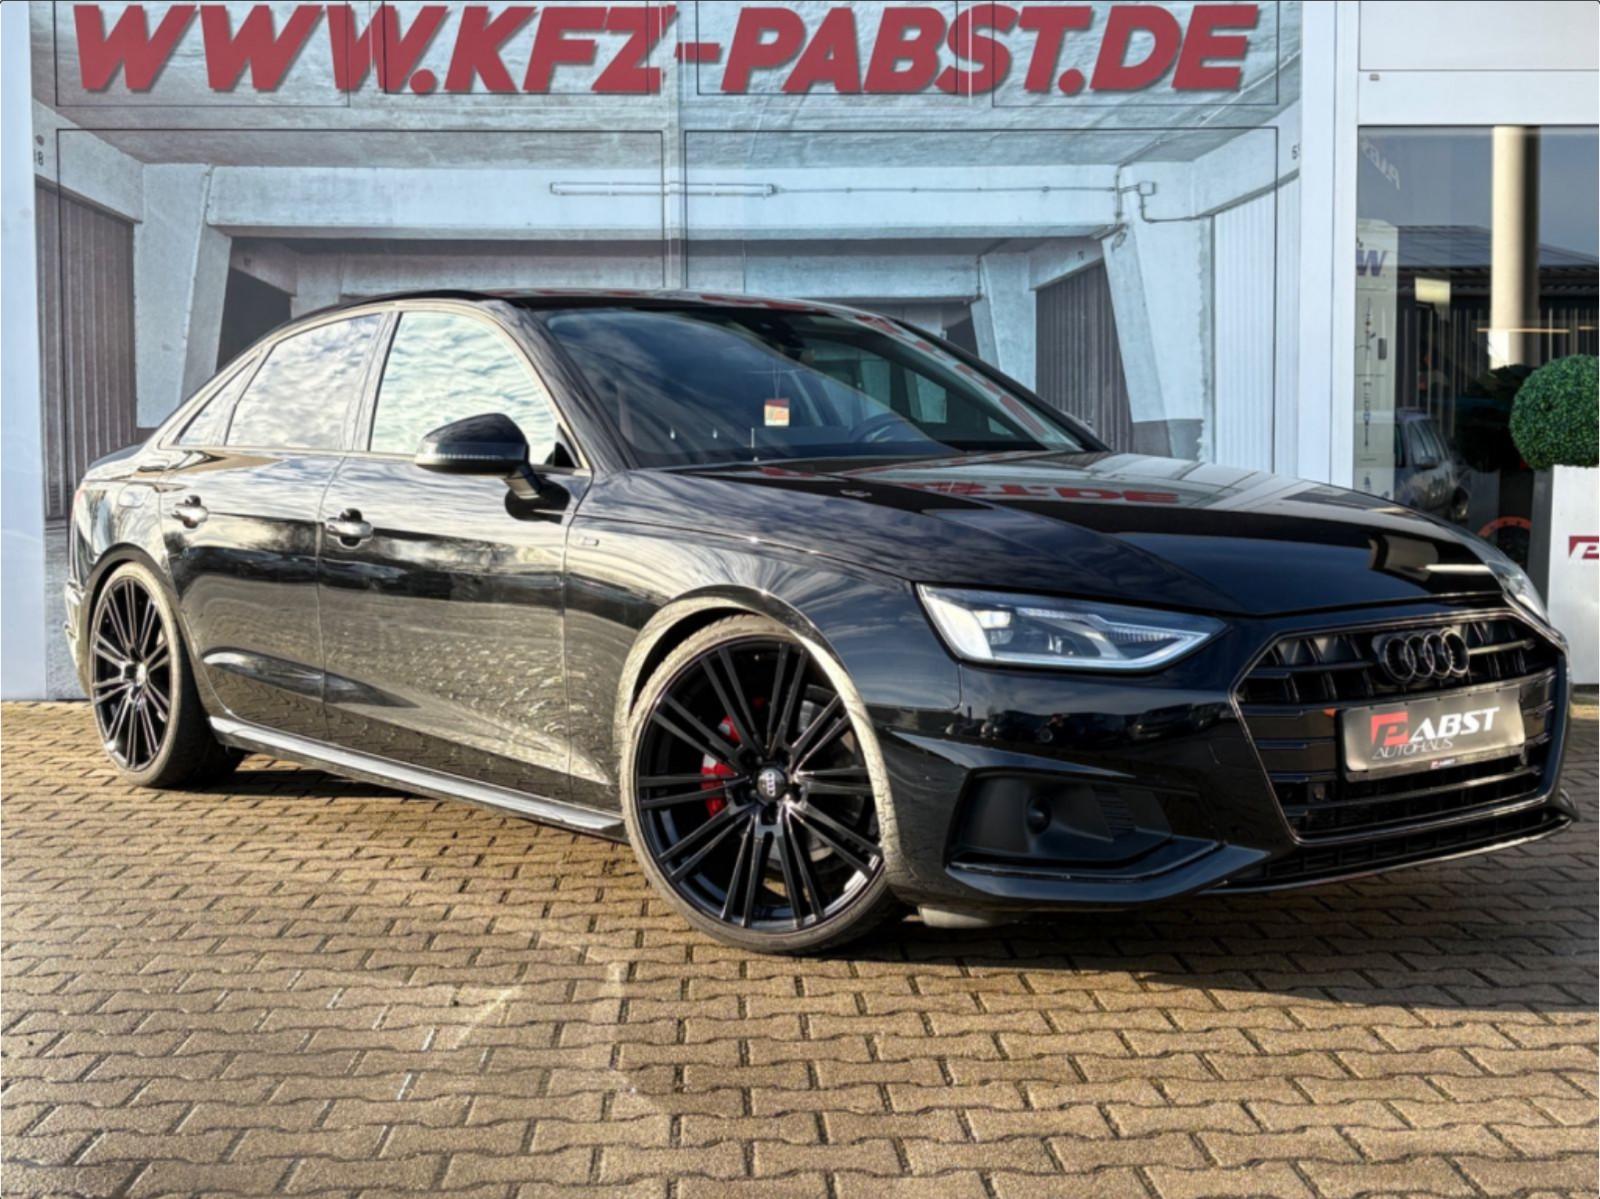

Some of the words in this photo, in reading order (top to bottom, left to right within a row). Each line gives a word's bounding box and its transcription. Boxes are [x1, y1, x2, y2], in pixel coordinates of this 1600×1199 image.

[75, 5, 1257, 93] WWW.KFZ-PABST.DE
[1371, 707, 1500, 747] PABST
[1371, 738, 1454, 760] AUTOHAUS
